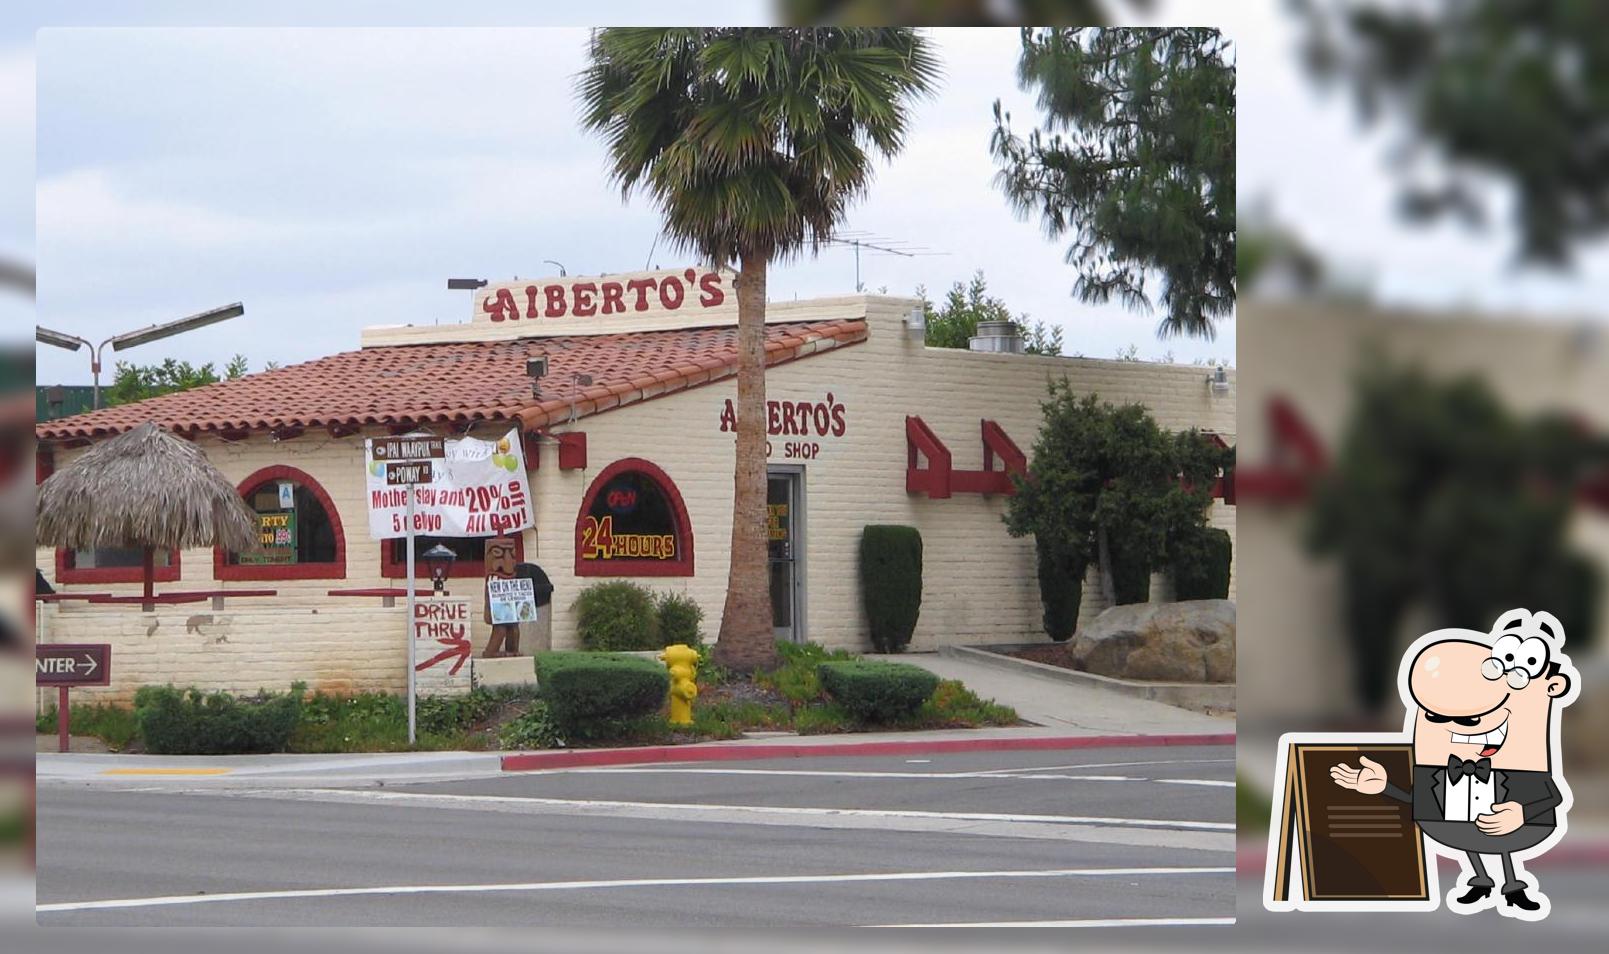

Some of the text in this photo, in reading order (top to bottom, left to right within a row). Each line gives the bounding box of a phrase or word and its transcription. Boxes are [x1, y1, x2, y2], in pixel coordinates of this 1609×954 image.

[720, 392, 846, 437] AERTO'S
[785, 442, 820, 459] SHOP
[396, 465, 420, 483] POWAY
[283, 487, 290, 498] A
[466, 483, 510, 513] 20%
[508, 481, 525, 506] off
[262, 516, 288, 527] RTY
[393, 514, 400, 532] 5
[466, 507, 527, 532] All Day!
[583, 516, 674, 559] 24 HOURS
[490, 579, 532, 593] NEW ON THE MENU
[415, 622, 465, 640] THRU
[36, 657, 75, 673] NTER
